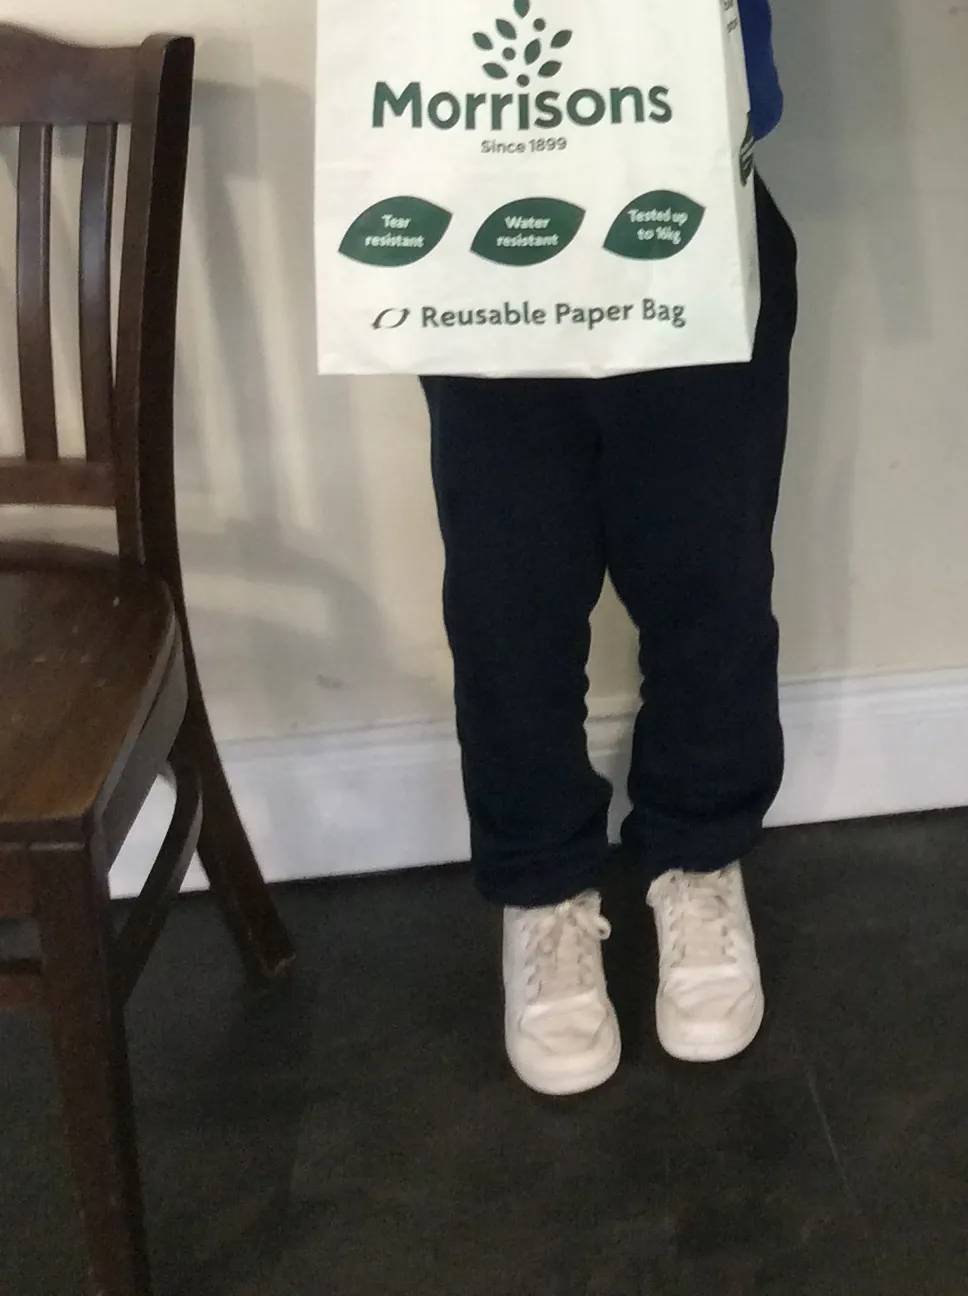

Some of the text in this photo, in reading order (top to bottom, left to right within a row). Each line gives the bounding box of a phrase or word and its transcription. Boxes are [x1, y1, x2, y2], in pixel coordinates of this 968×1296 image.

[372, 80, 673, 131] Morrisons
[480, 136, 568, 154] Since 1899
[381, 214, 411, 229] Tear
[504, 215, 551, 230] Water
[627, 206, 689, 227] Tested up
[364, 232, 425, 248] resistant
[496, 233, 559, 248] resistant
[636, 227, 655, 241] to
[421, 297, 687, 331] Reusable Paper Bag
